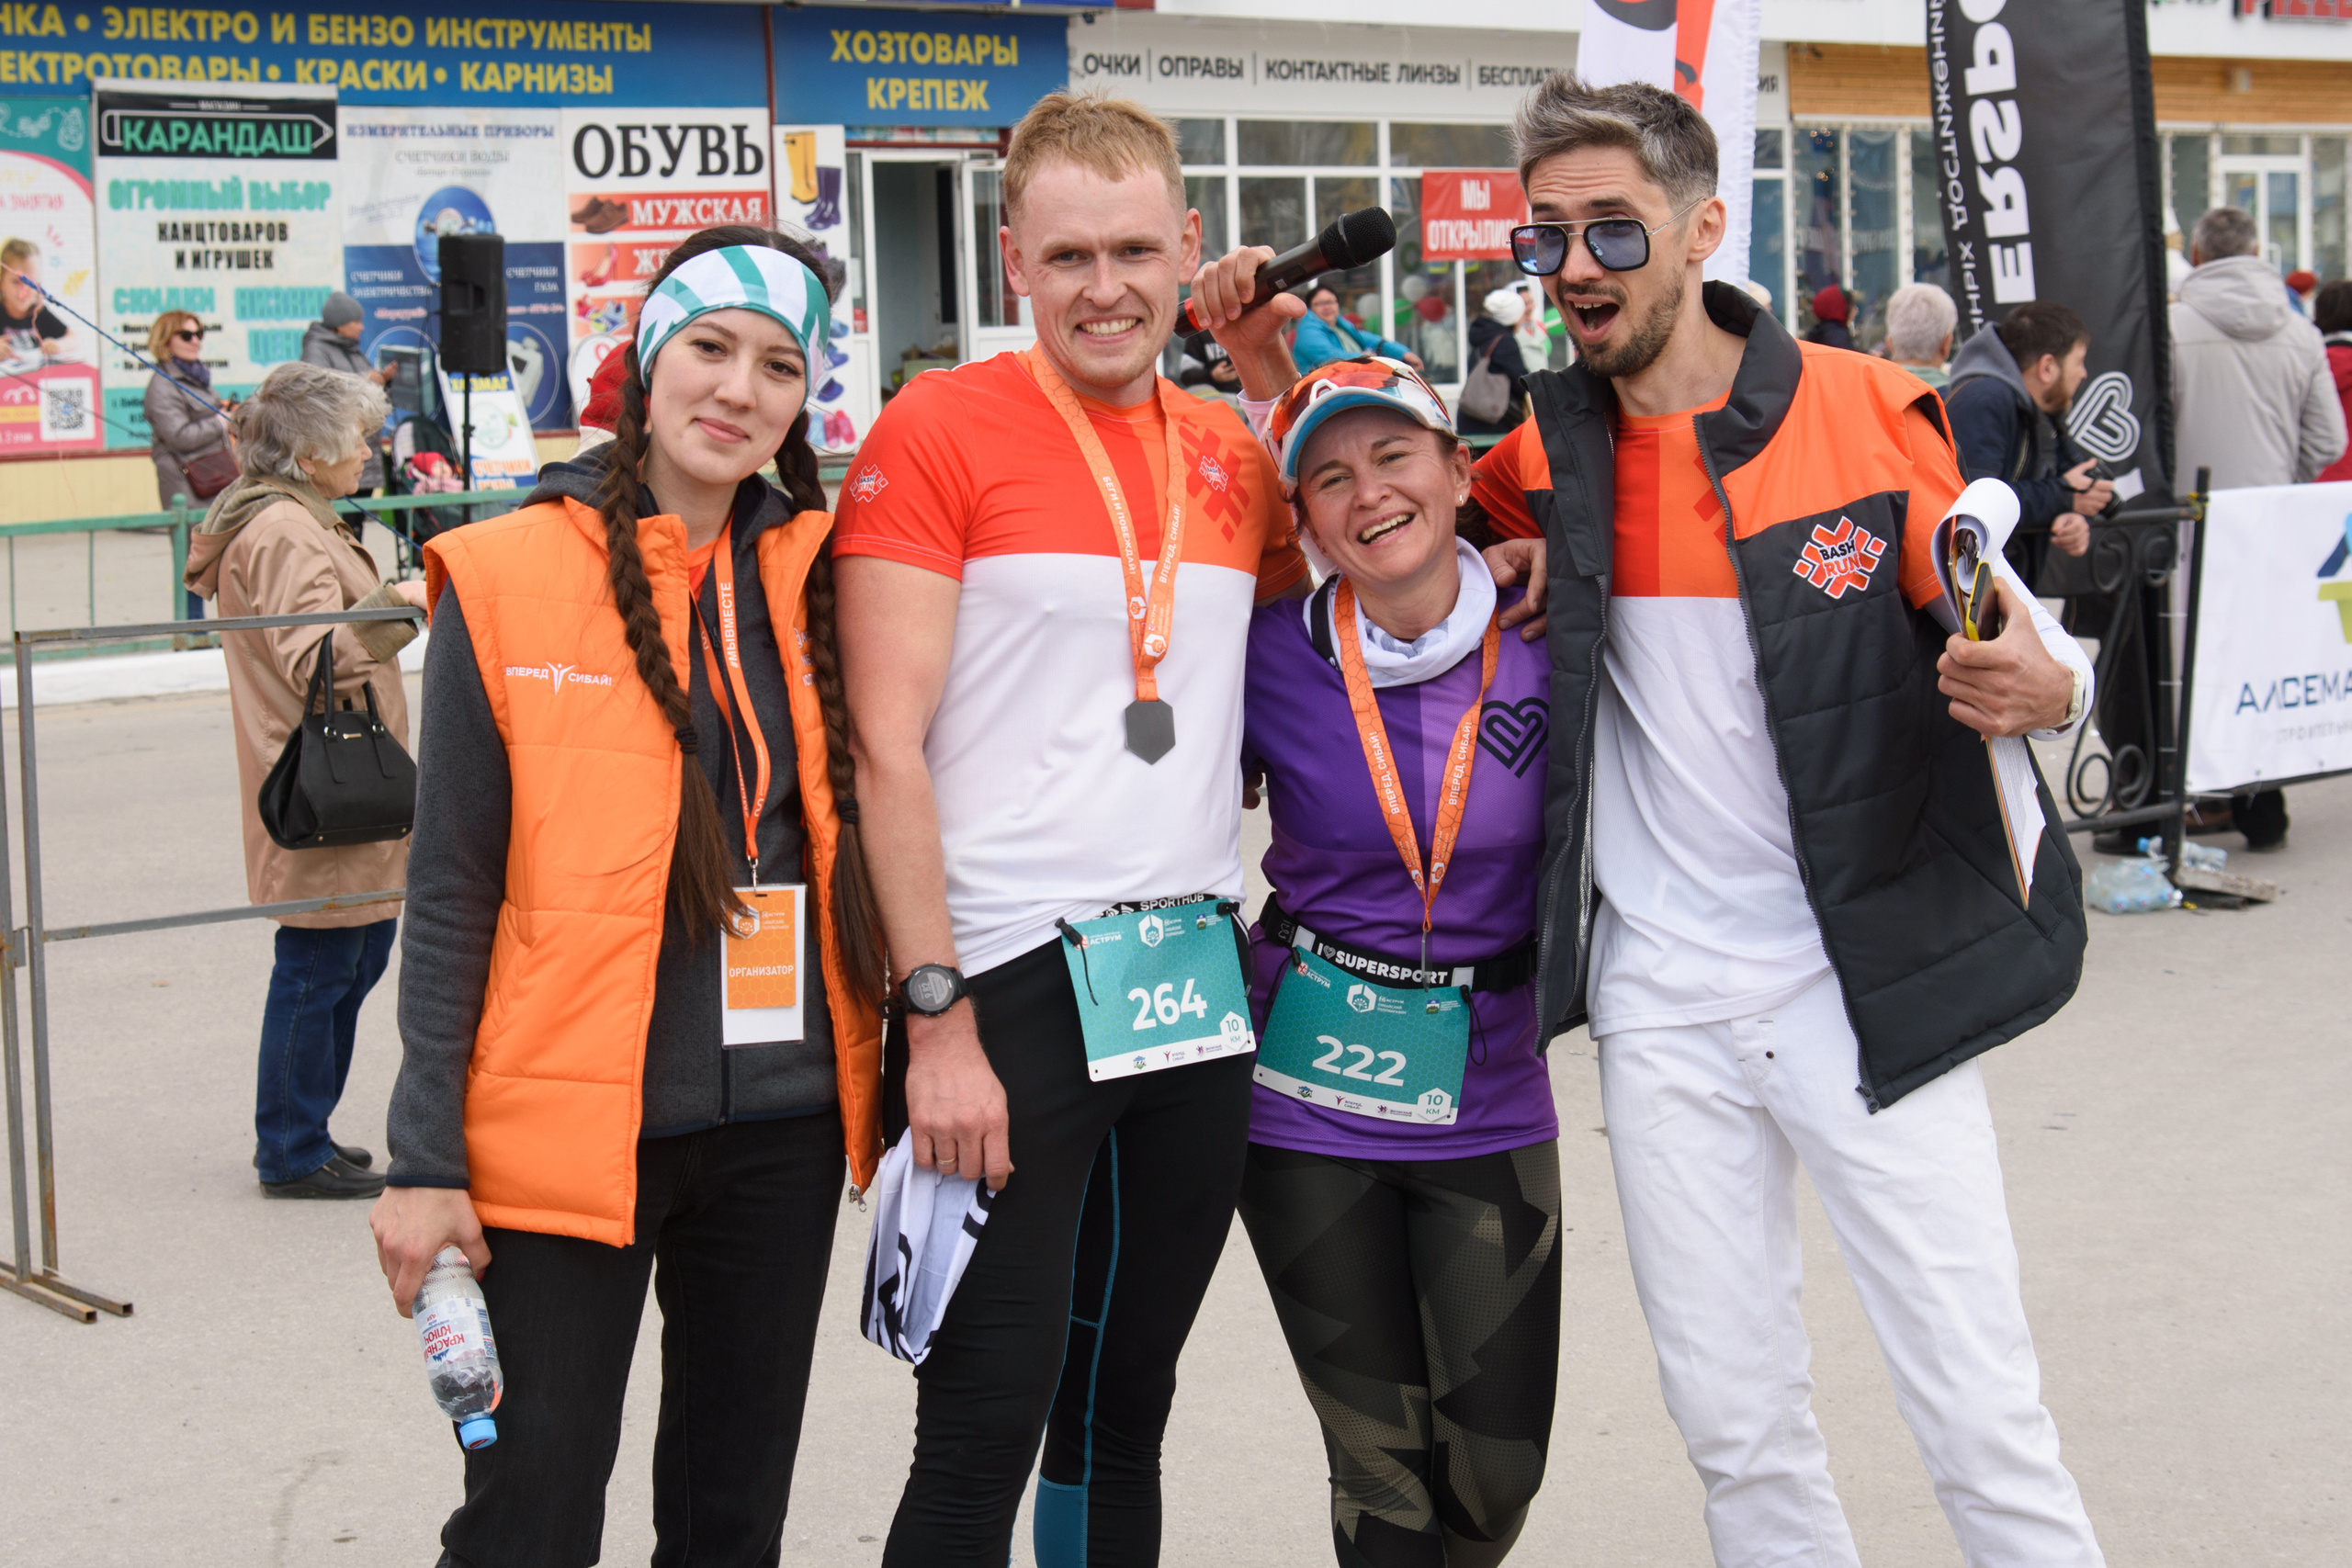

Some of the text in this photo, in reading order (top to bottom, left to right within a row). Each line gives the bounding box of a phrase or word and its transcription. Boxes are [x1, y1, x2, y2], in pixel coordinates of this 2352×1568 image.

[102, 6, 259, 43] ЭЛЕКТРО
[271, 13, 296, 43] И
[308, 15, 414, 47] БЕНЗО
[425, 17, 651, 52] ИНСТРУМЕНТЫ
[831, 29, 1018, 66] ХОЗТОВАРЫ
[0, 51, 613, 94] ЕКТРОТОВАРЫ КРАСКИ КАРНИЗЫ
[1083, 52, 1141, 77] ОЧКИ
[1159, 56, 1244, 79] ОПРАВЫ
[1266, 59, 1391, 83] КОНТАКТНЫЕ
[1396, 63, 1461, 85] ЛИНЗЫ
[867, 77, 989, 110] КРЕПЕЖ
[123, 118, 312, 157] КАРАНДАШ
[345, 123, 554, 138] ИЗМЕРИТЕЛЬНЫЕ ПРИБОРЫ
[572, 123, 764, 179] ОБУВЬ
[108, 177, 243, 210] ОГРОМНЫЙ
[249, 180, 332, 210] ВЫБОР
[1461, 180, 1491, 211] МЫ
[631, 197, 763, 226] МУЖСКАЯ
[158, 221, 288, 244] КАНЦТОВАРОВ
[1428, 220, 1520, 252] ОТКРЫЛИС
[175, 250, 274, 270] И ИГРУШЕК
[113, 288, 215, 313] СКИДКИ
[1102, 476, 1119, 501] БЕГИ
[1117, 512, 1136, 575] ПОБЕЖДАЙ!
[1159, 504, 1181, 583] ВПЕРЕД, СИБАЙ!
[1819, 538, 1856, 560] BASH
[1824, 552, 1860, 577] RUN
[720, 581, 739, 668] #МЫВМЕСТЕ
[505, 666, 612, 686] ВПЕРЕД СИБАЙ!
[1369, 731, 1400, 815] ВПЕРЕД, СИБАЙ!
[1449, 721, 1473, 806] ВПЕРЕД, СИБАЙ!
[1140, 893, 1204, 911] SPORTHUB
[1090, 934, 1122, 945] АСТРУМ
[729, 965, 794, 978] ОРГАНИЗАТОР
[1306, 971, 1331, 988] АСТРУМ
[1335, 951, 1448, 985] SUPERSPORT
[1127, 978, 1208, 1031] 264
[1226, 1019, 1239, 1032] 10
[1311, 1035, 1407, 1087] 222
[1427, 1094, 1443, 1106] 10
[424, 1325, 452, 1346] КЛЮЧ
[424, 1333, 465, 1362] КРАСНЫ
